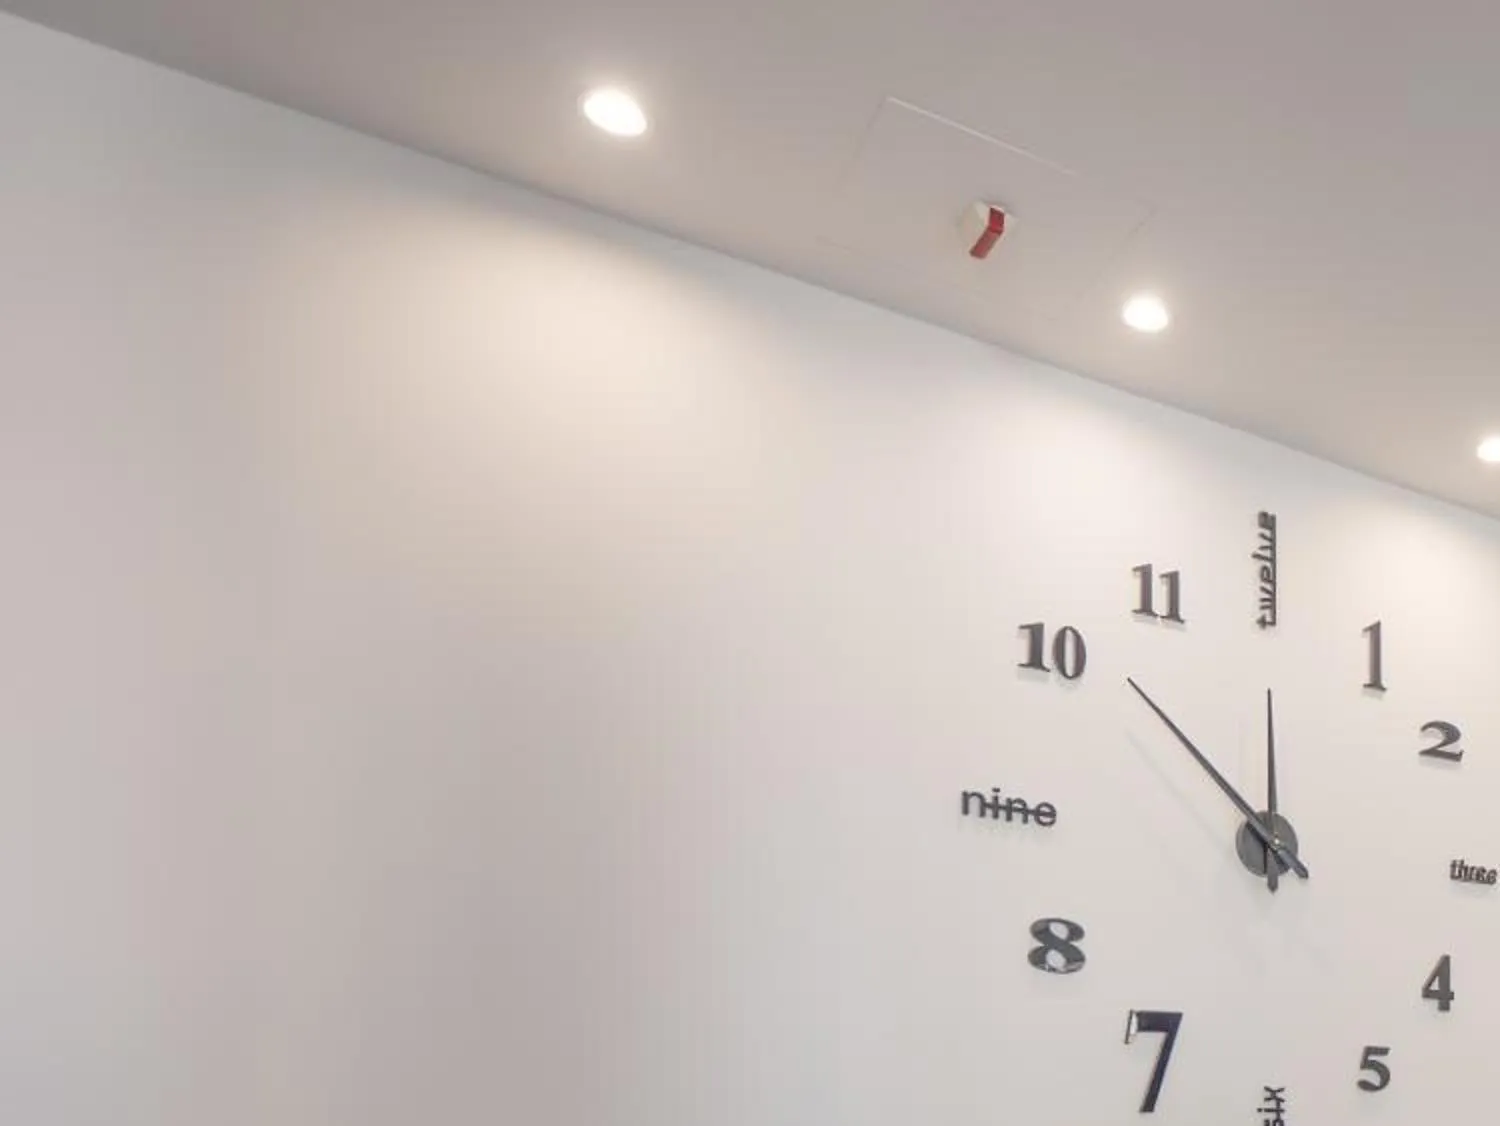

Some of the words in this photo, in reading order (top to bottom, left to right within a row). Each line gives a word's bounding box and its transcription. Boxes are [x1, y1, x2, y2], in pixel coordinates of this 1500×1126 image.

[1132, 564, 1186, 624] 11
[1251, 511, 1277, 629] twelve
[1017, 622, 1087, 681] 10
[1362, 621, 1387, 692] 1
[1418, 720, 1464, 762] 2
[961, 787, 1057, 827] nine
[1449, 859, 1498, 886] three
[1027, 918, 1086, 975] 8
[1421, 954, 1455, 1012] 4
[1124, 1009, 1183, 1114] 7
[1357, 1045, 1391, 1093] 5
